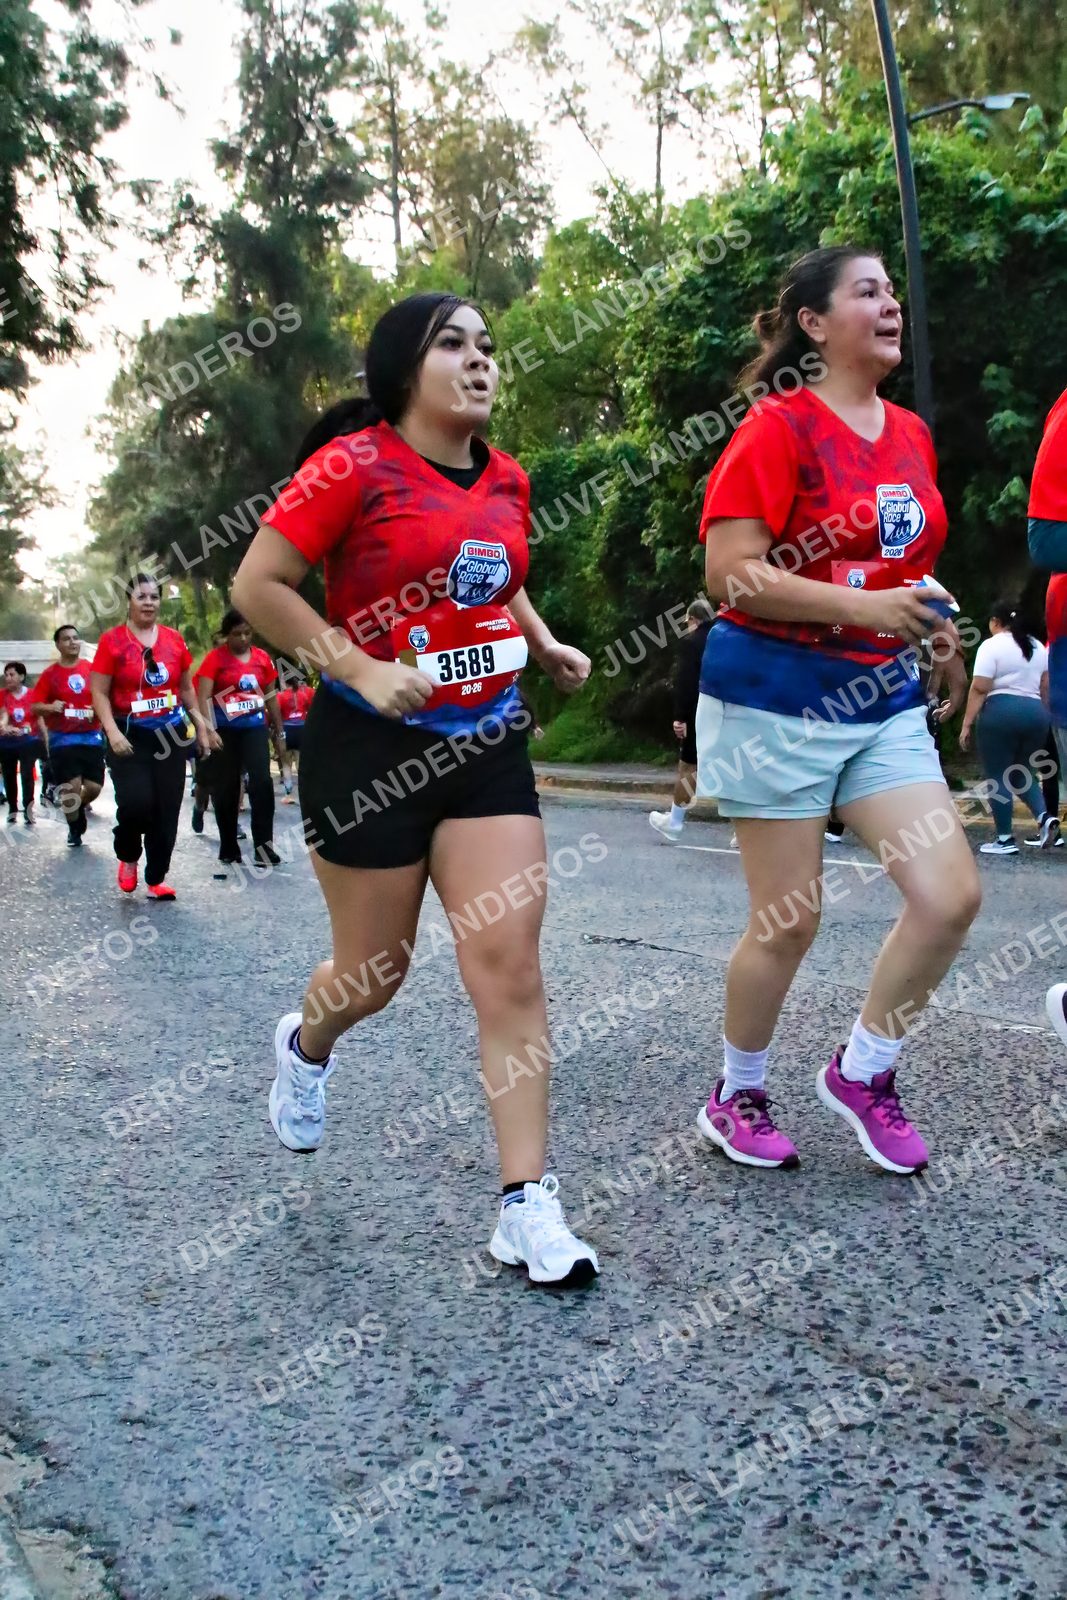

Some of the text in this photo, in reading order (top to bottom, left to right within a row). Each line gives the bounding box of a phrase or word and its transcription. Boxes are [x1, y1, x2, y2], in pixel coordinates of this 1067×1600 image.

[881, 490, 908, 498] BIMBO
[886, 501, 910, 513] Global
[883, 512, 901, 523] Race
[467, 547, 500, 559] BIMBO
[466, 560, 499, 575] Global
[457, 571, 484, 584] Race
[437, 644, 495, 682] 3589
[147, 698, 164, 710] 1674
